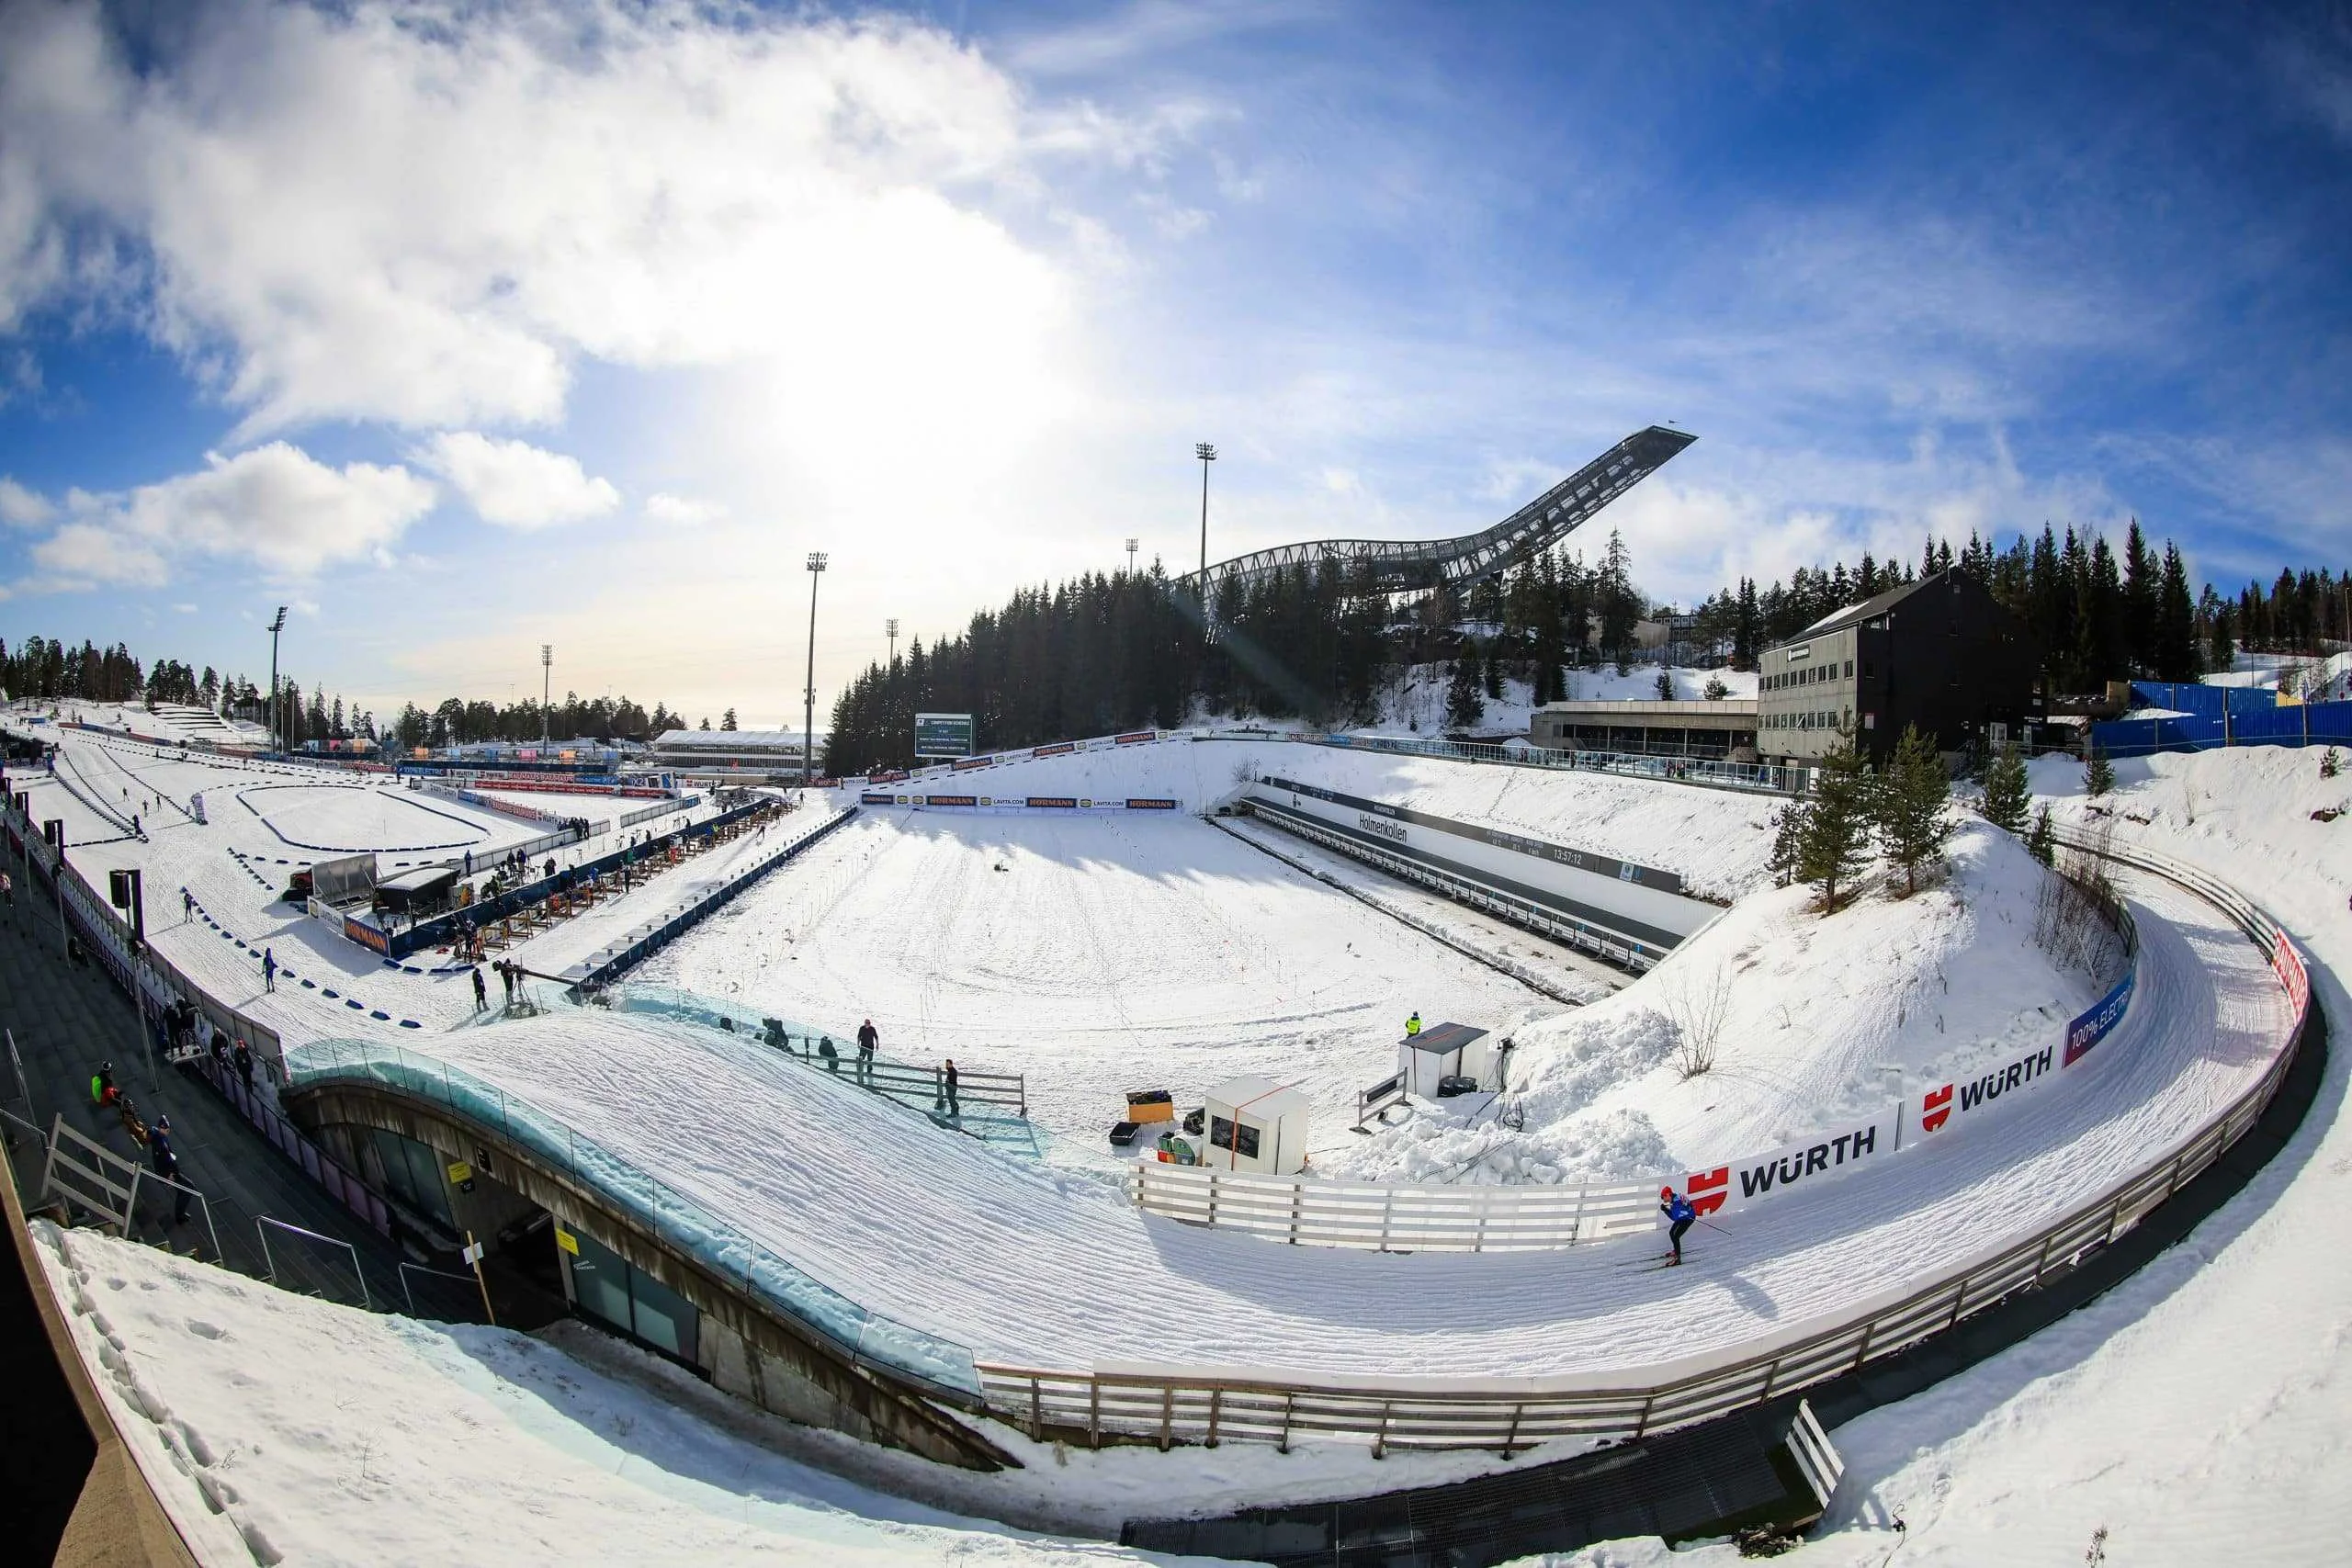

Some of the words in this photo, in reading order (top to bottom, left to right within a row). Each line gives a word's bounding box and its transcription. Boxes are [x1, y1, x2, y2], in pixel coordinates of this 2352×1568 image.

[1359, 813, 1408, 843] Holmenkollen
[1554, 848, 1582, 865] 13:57:12
[2072, 1017, 2098, 1050] 100%
[1960, 1044, 2052, 1112] WÜRTH
[1739, 1124, 1876, 1199] WÜRTH
